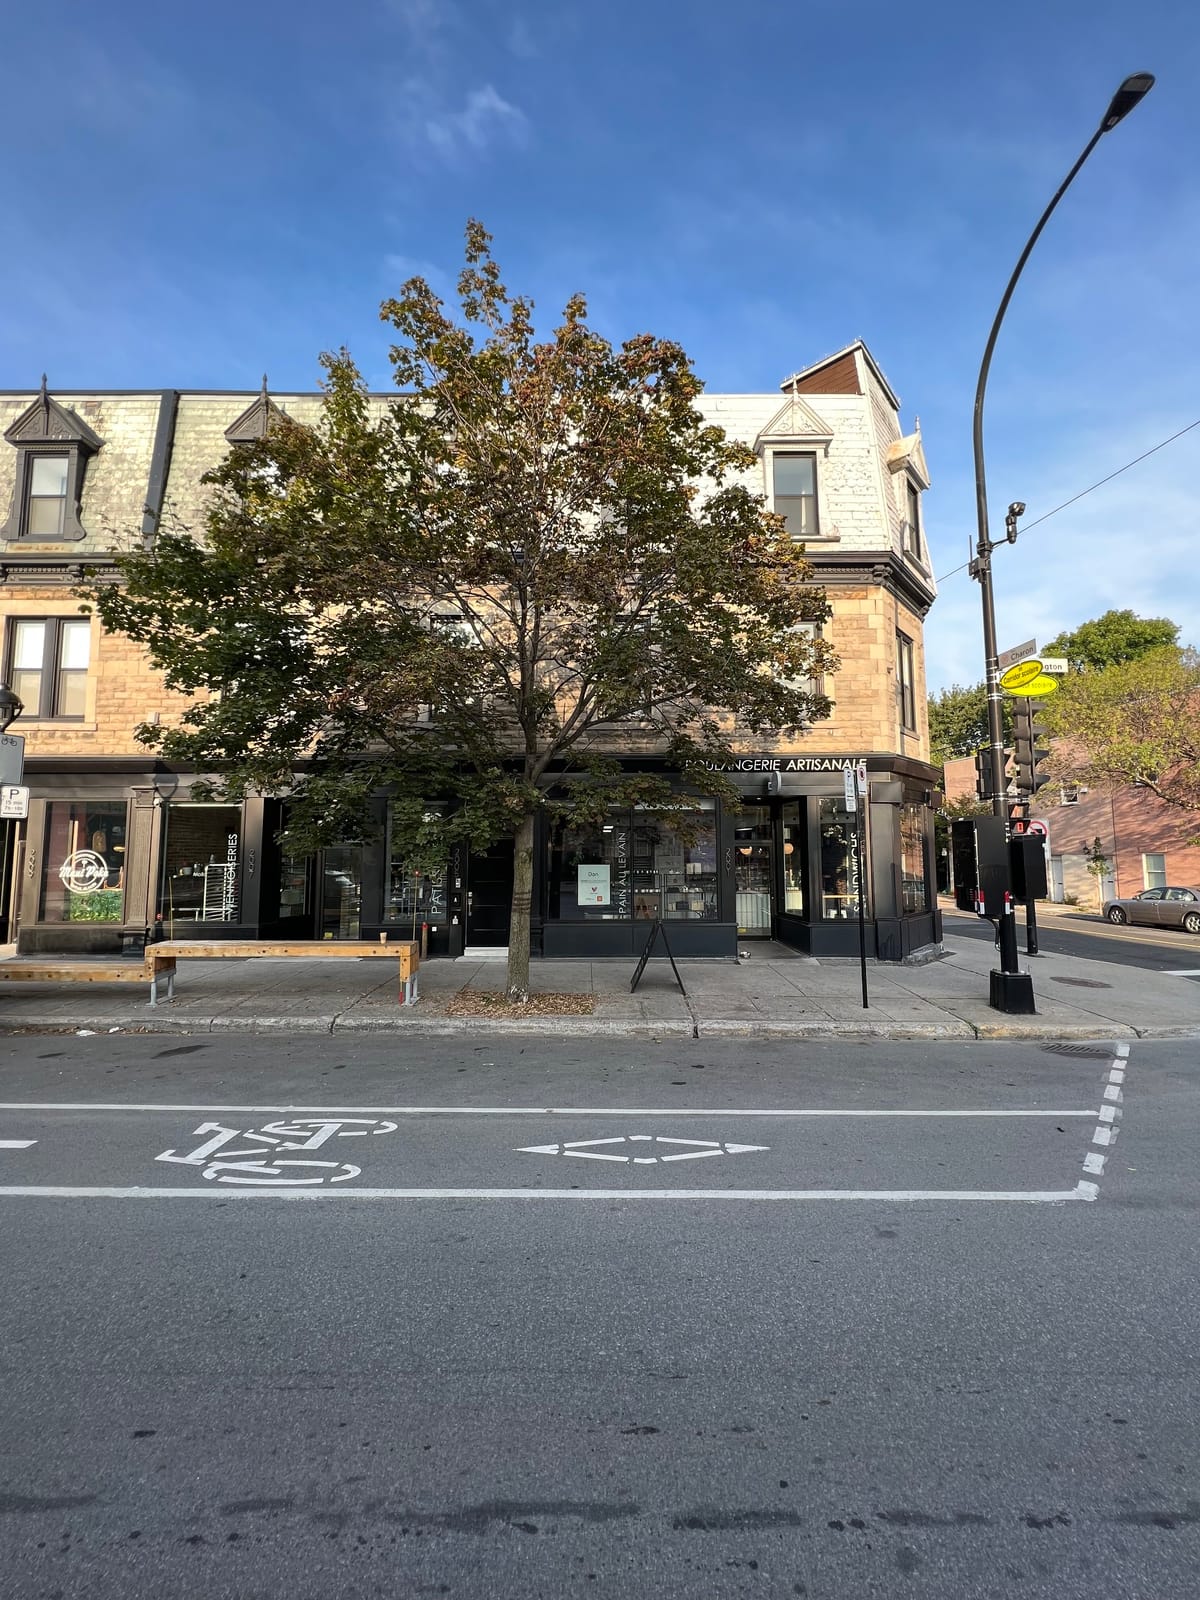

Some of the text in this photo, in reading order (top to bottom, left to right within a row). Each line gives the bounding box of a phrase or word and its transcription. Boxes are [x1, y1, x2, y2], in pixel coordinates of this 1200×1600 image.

[1010, 646, 1034, 661] Charon
[786, 758, 868, 771] ARTISANALE
[9, 788, 20, 800] P
[618, 832, 627, 869] LEVAIN
[618, 889, 627, 914] PAIN
